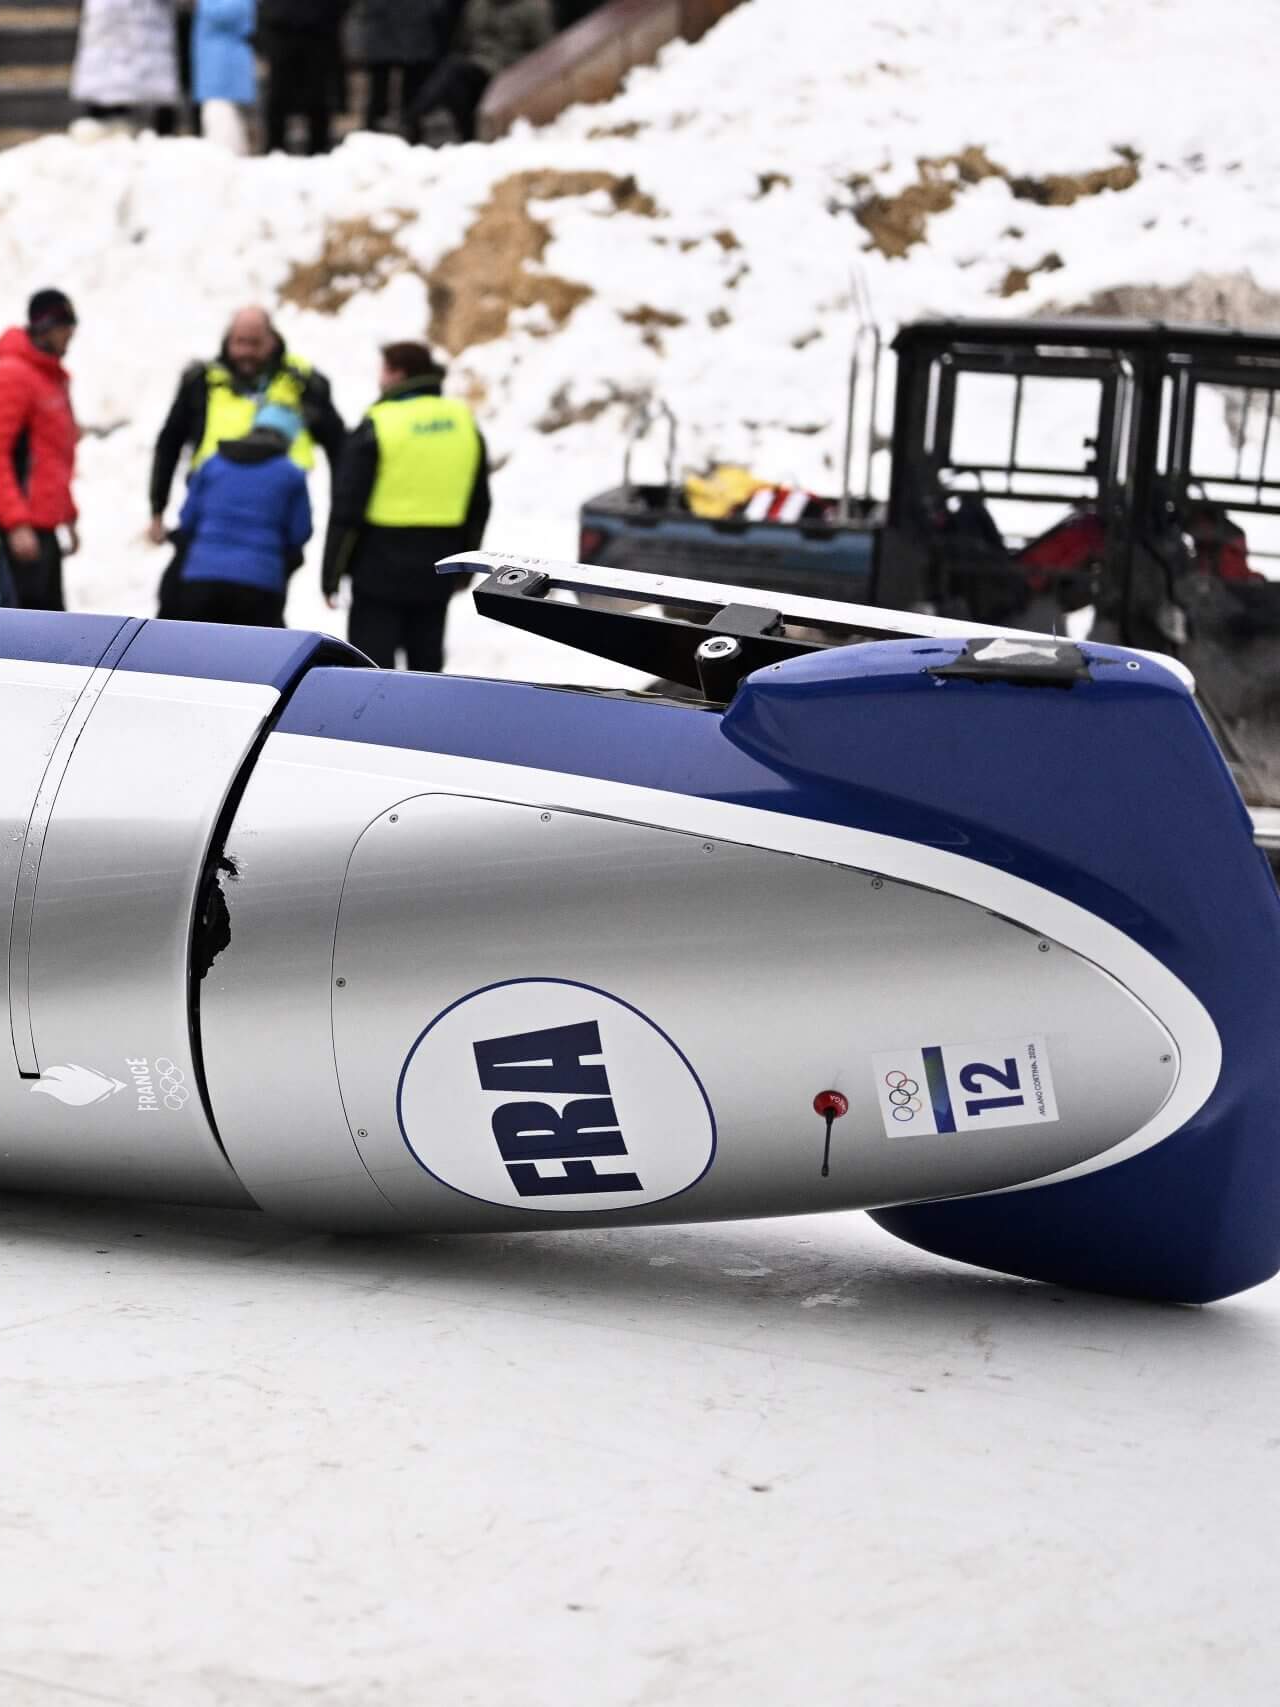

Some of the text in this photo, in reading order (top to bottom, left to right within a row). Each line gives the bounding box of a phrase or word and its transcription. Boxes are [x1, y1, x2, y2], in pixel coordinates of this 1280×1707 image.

[125, 1057, 160, 1111] FRANCE
[473, 1020, 644, 1197] FRA
[959, 1058, 1024, 1116] 12
[1035, 1091, 1046, 1116] MILANO
